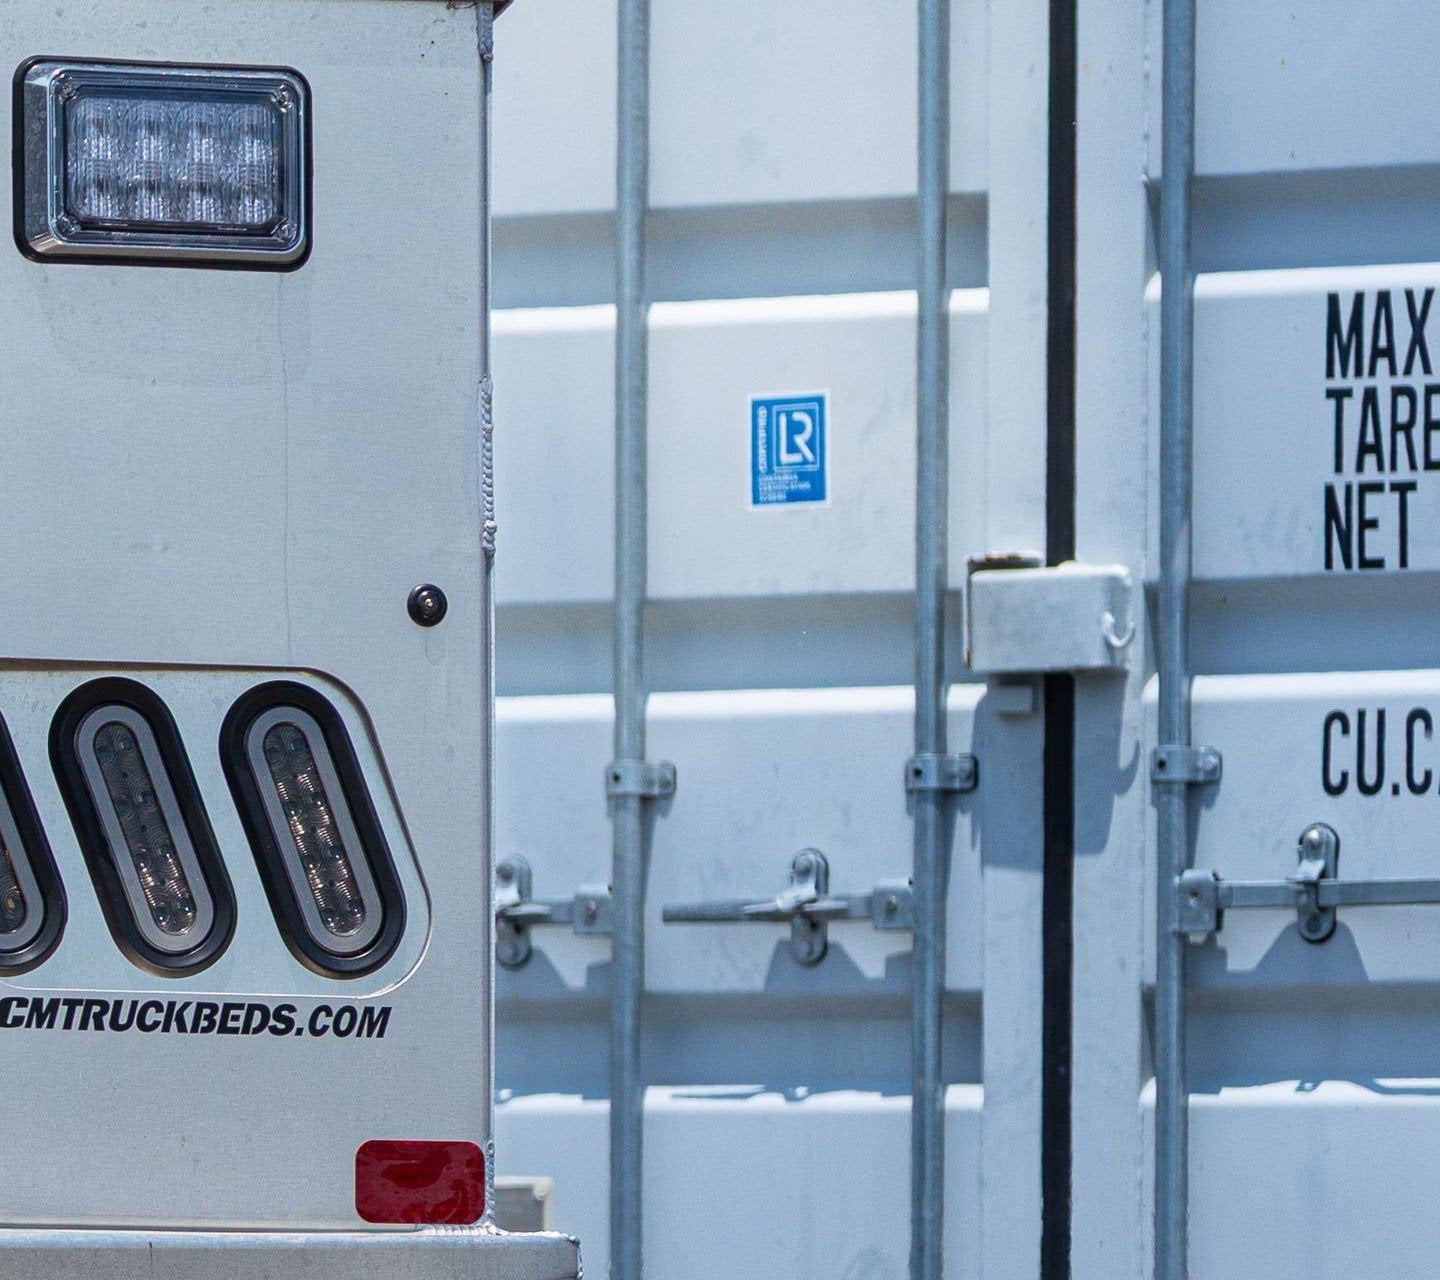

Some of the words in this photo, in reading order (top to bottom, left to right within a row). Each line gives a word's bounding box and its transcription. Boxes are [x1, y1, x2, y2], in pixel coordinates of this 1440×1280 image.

[1325, 287, 1436, 380] MAX
[778, 411, 817, 465] LR
[1325, 384, 1440, 474] TARE
[1323, 480, 1418, 571] NET
[1321, 707, 1440, 797] CU.C
